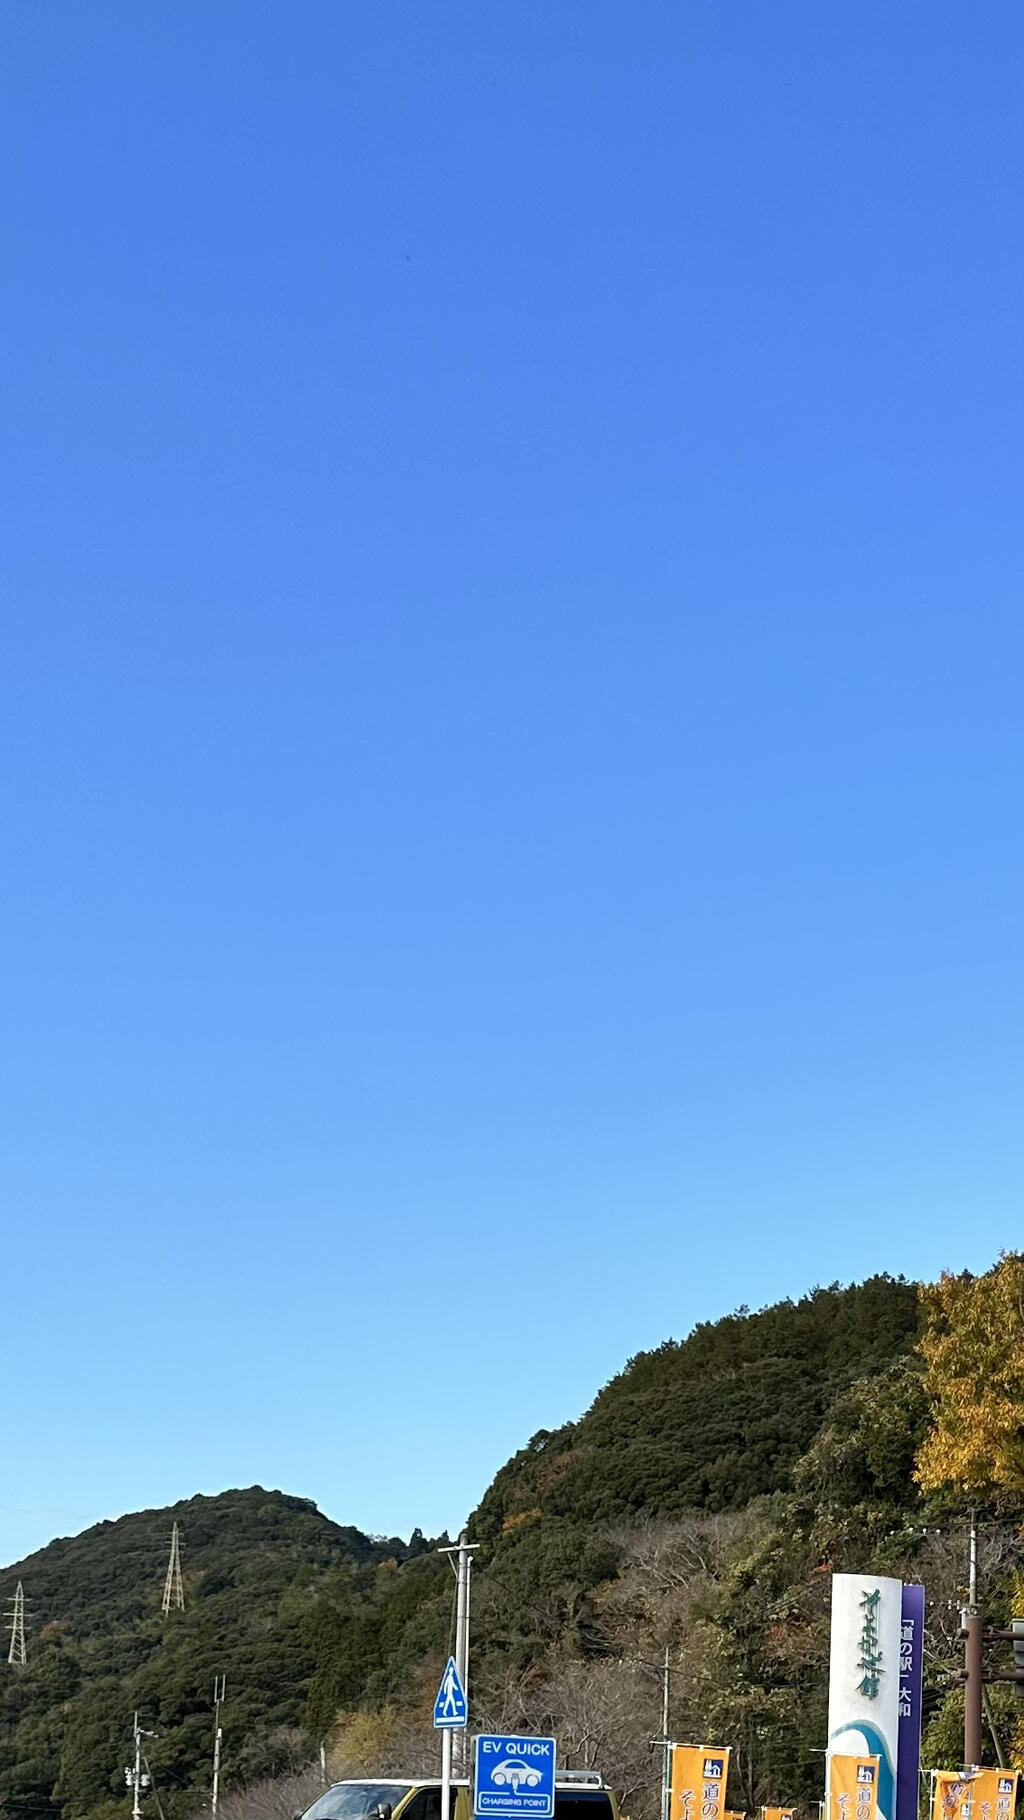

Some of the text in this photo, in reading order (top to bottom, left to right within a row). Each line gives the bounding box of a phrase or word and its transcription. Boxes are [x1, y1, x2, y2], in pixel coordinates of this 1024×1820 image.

[482, 1741, 550, 1756] EV QUICK
[482, 1797, 547, 1807] CHARGING POINT
